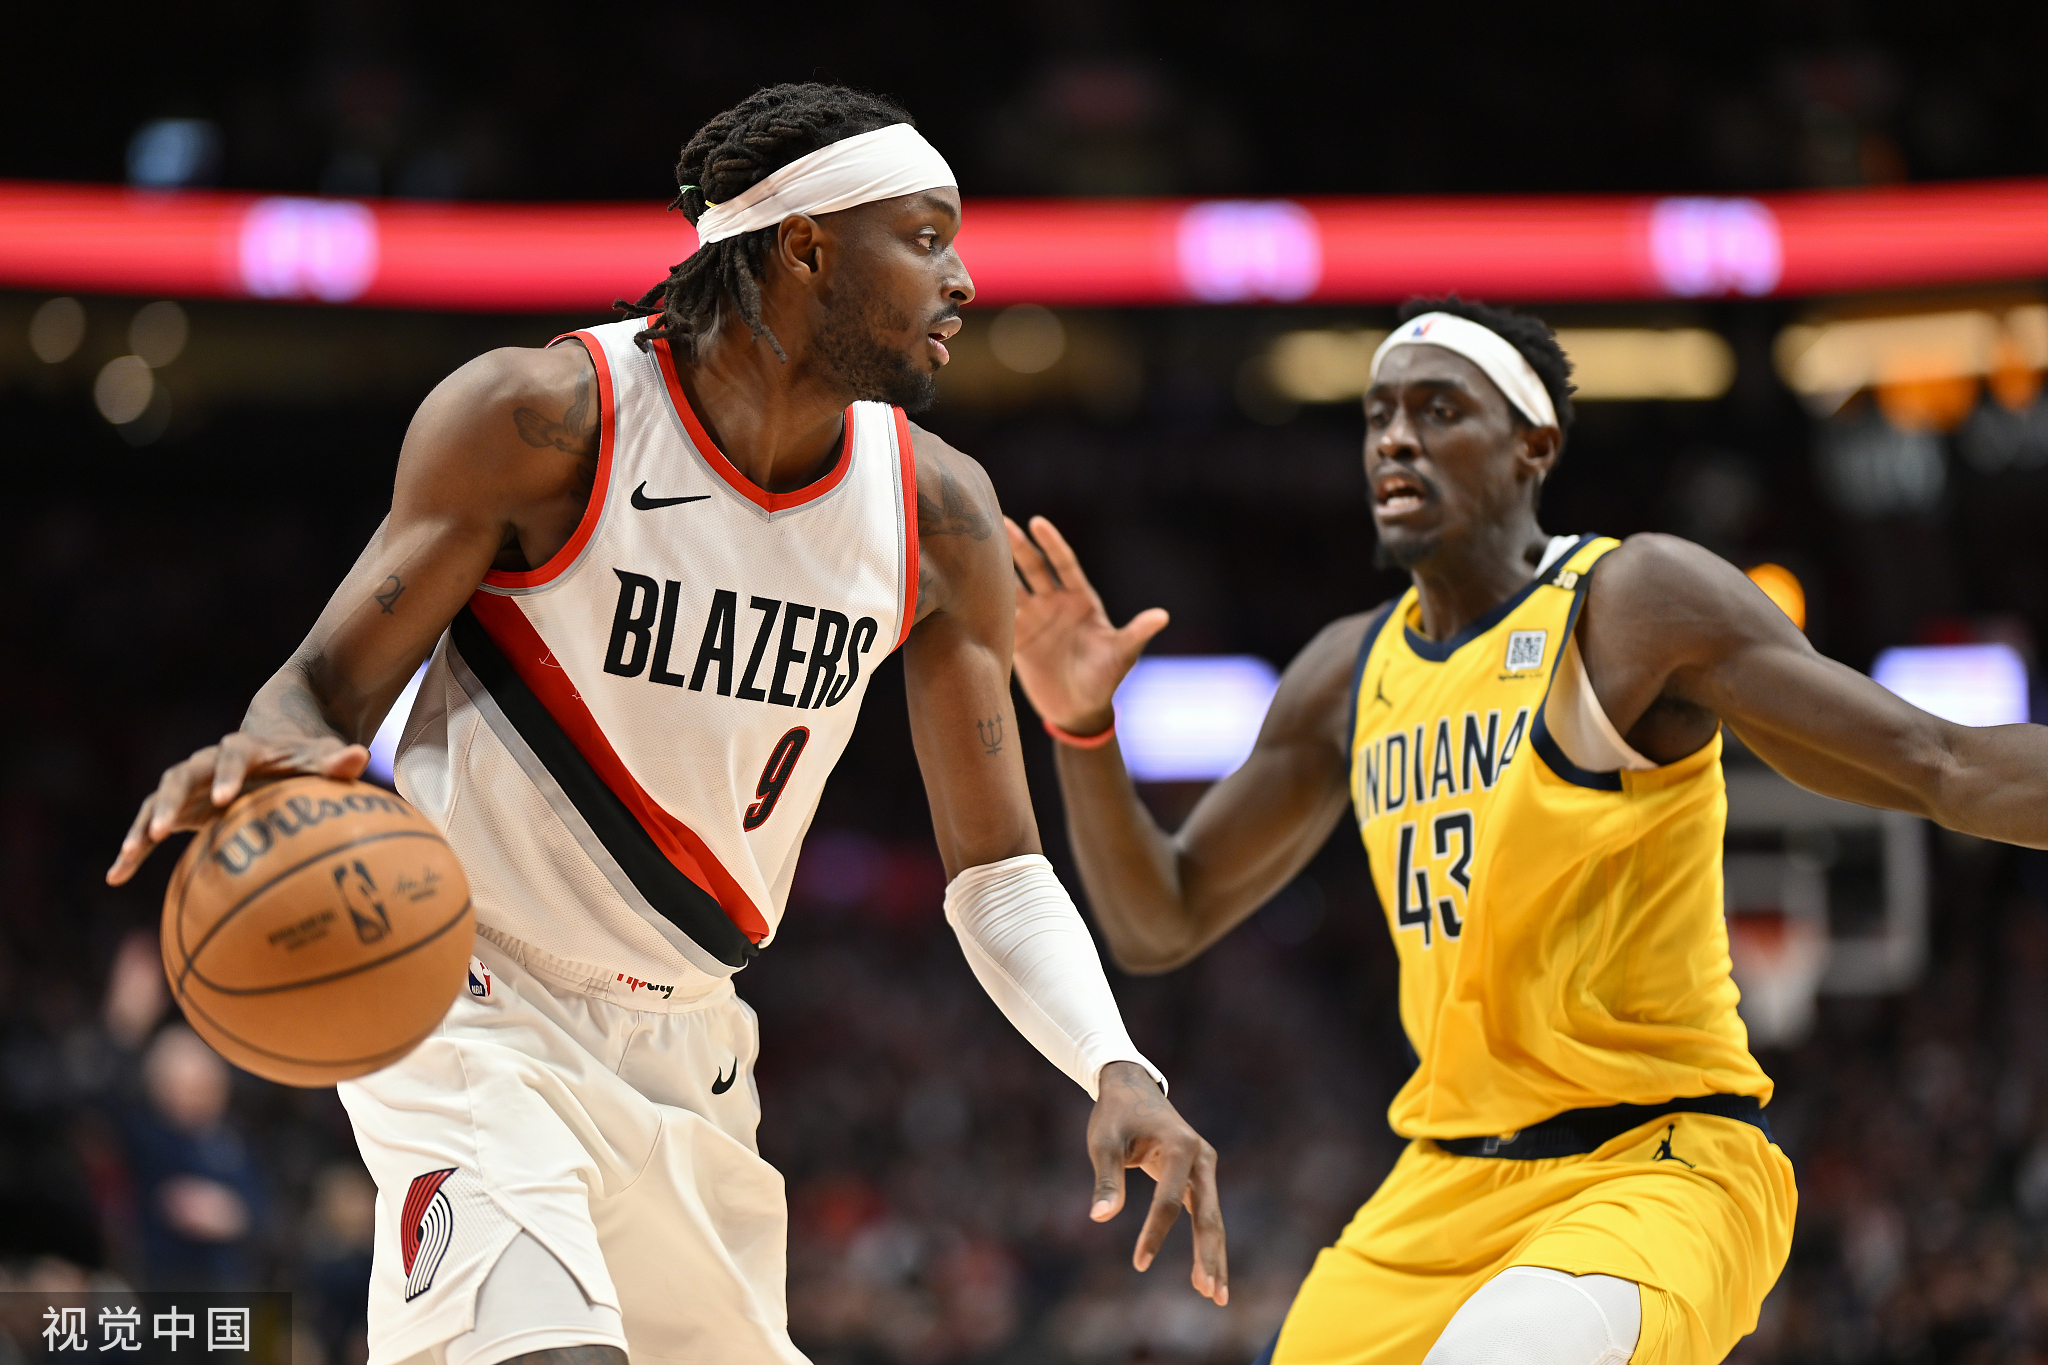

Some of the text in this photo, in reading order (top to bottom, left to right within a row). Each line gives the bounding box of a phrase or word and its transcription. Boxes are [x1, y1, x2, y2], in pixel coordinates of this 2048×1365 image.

[603, 567, 878, 709] BLAZERS
[743, 725, 810, 832] 9
[1357, 706, 1530, 830] INDIANA
[214, 794, 410, 876] Wilson
[1397, 811, 1474, 950] 43
